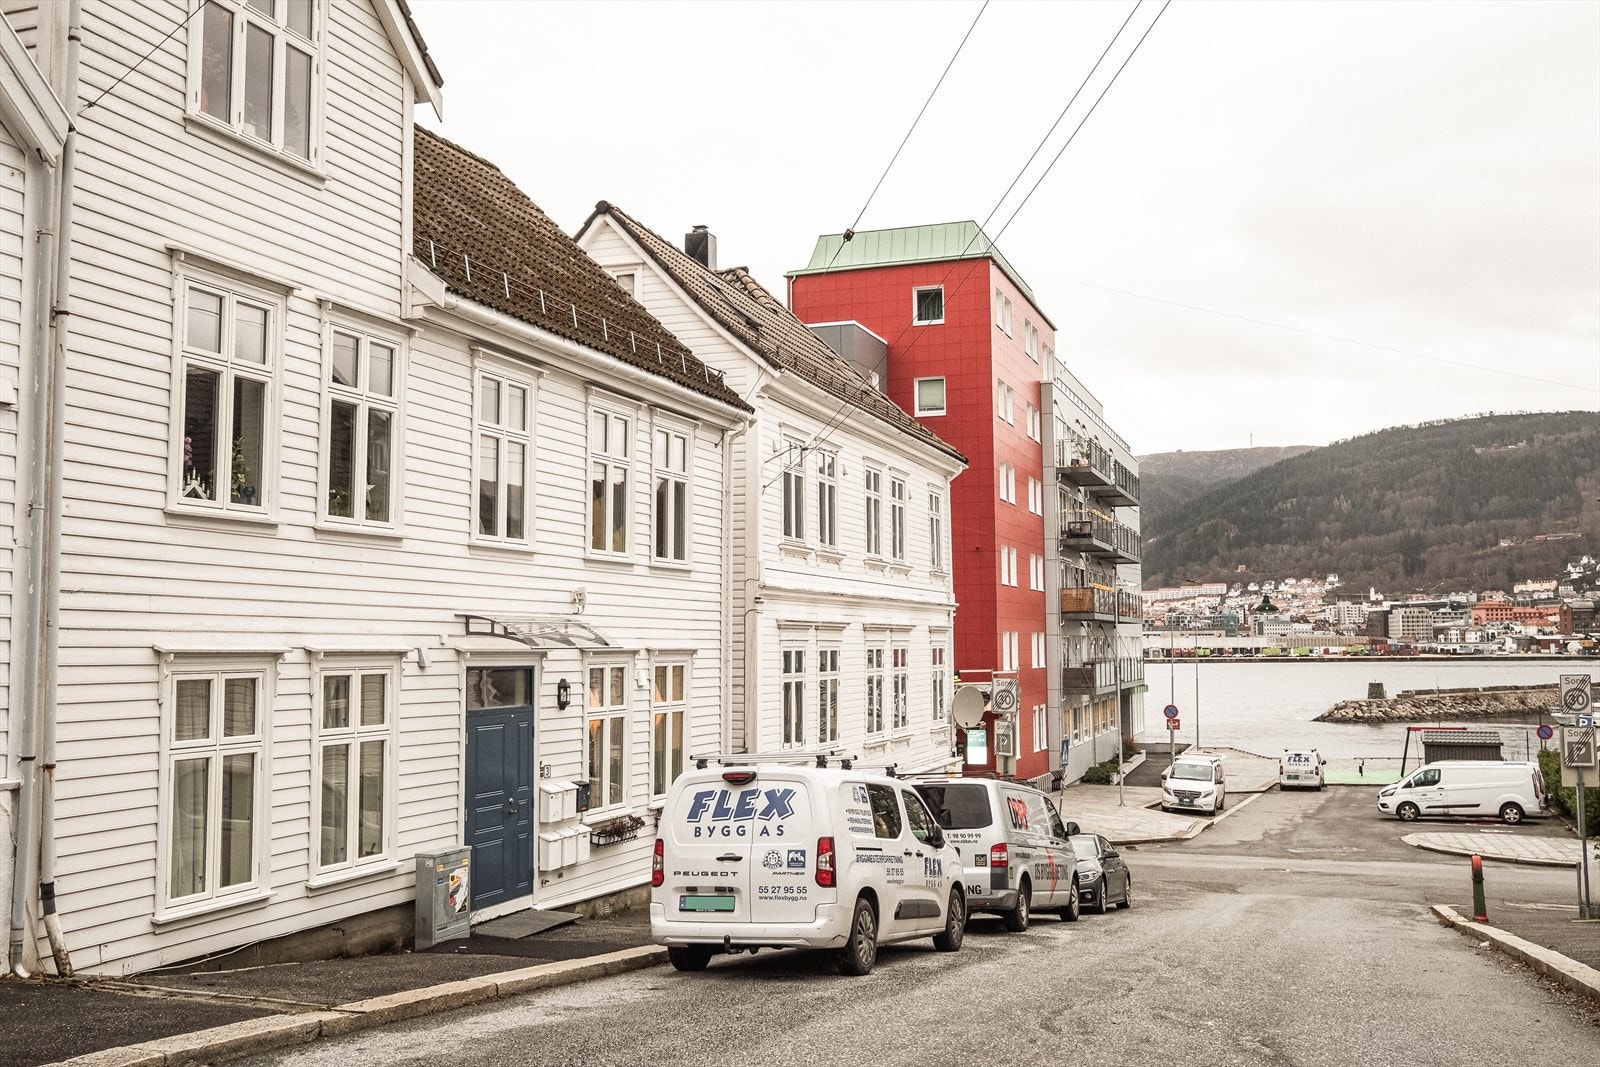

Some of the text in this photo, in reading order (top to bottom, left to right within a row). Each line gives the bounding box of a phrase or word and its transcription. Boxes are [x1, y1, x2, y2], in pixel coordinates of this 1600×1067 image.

[687, 788, 797, 822] FLEX
[694, 824, 784, 838] BYGG AS
[924, 857, 943, 879] FLEX
[758, 885, 808, 894] 55 27 95 55
